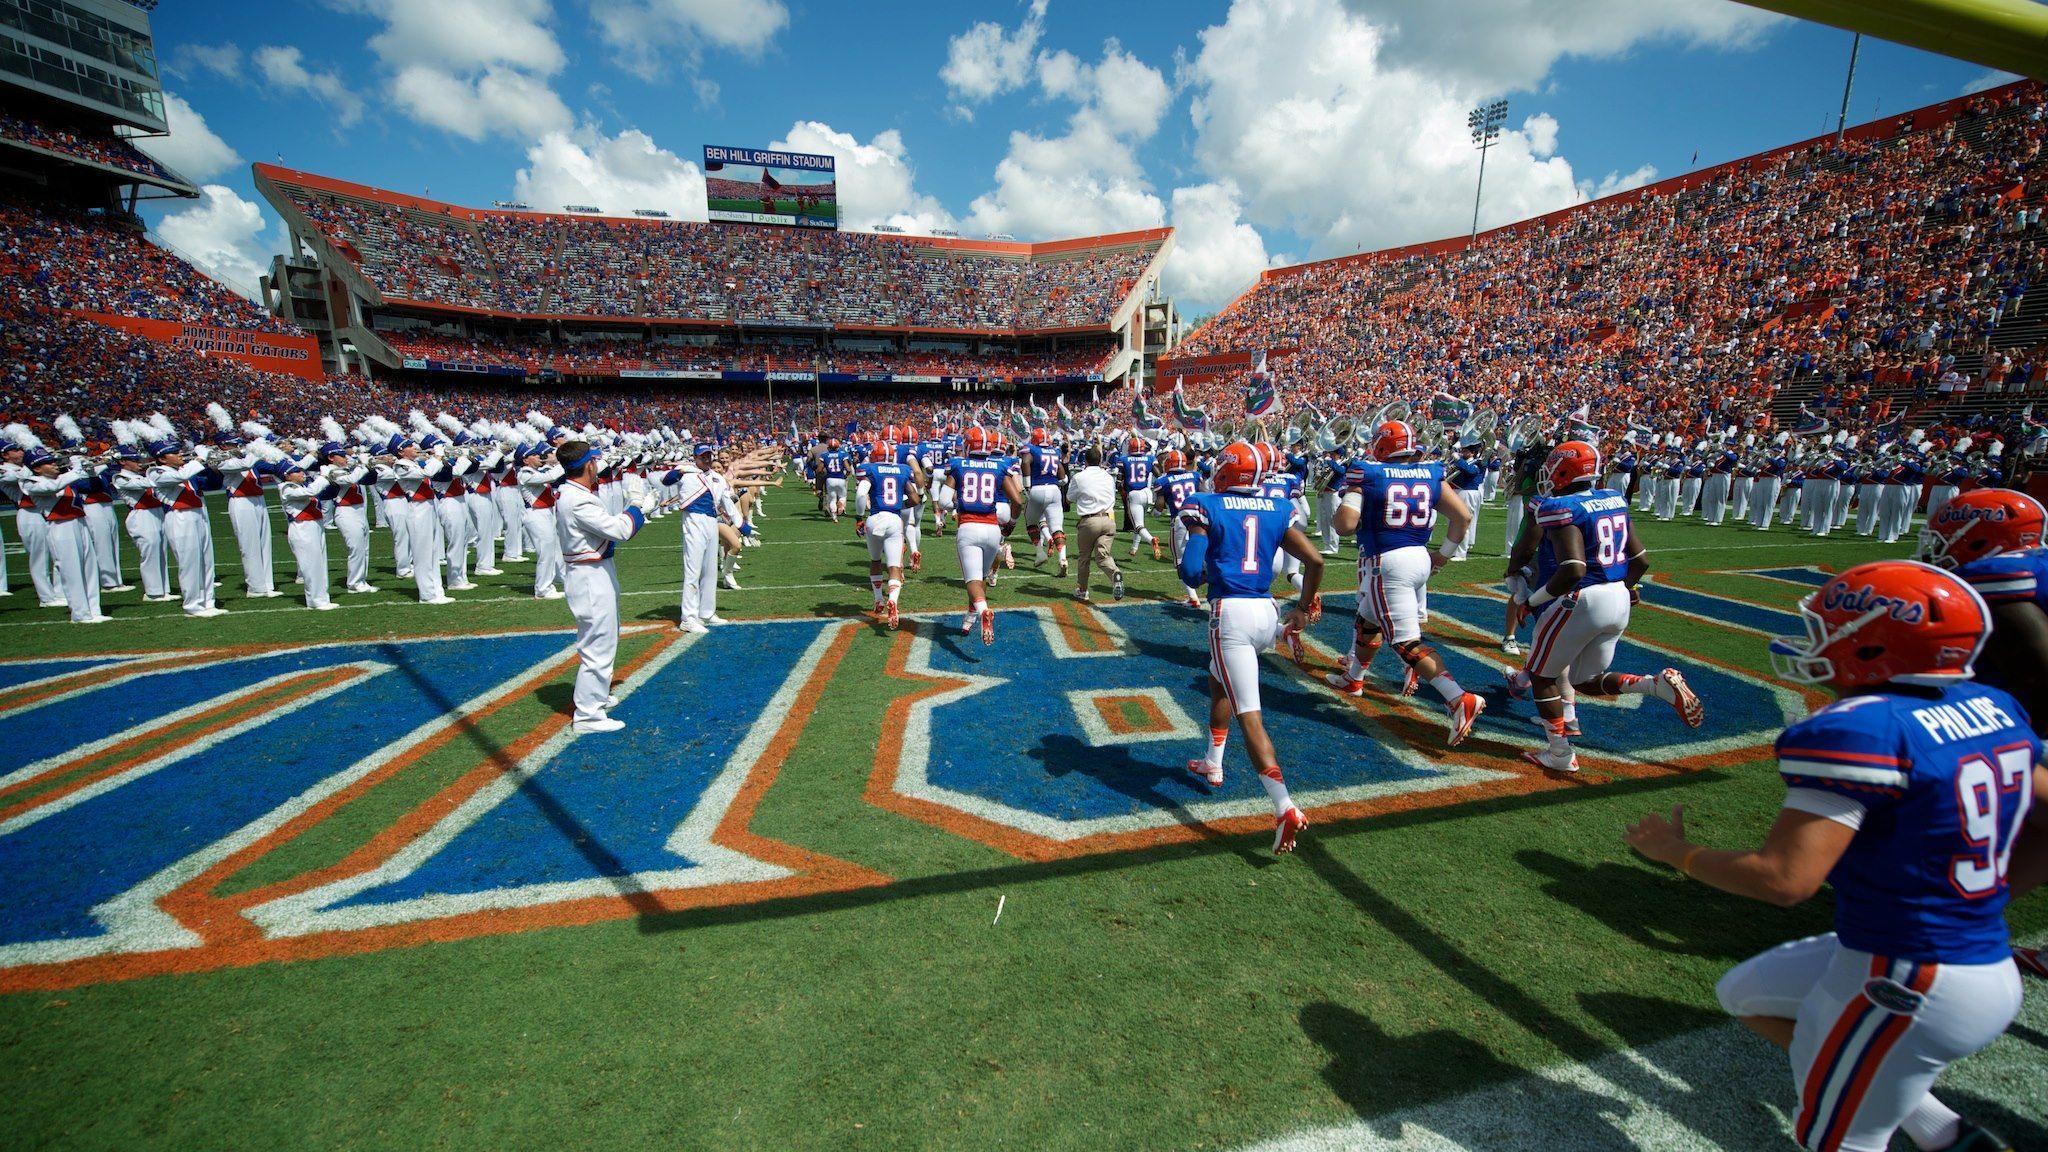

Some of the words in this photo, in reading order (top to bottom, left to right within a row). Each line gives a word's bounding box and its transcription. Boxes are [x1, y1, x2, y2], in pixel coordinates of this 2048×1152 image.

[706, 147, 728, 160] BEN
[730, 150, 752, 162] HILL
[753, 152, 791, 166] GRIFFIN
[793, 155, 833, 169] STADIUM
[759, 215, 788, 224] Publix
[182, 326, 215, 340] HOME
[217, 329, 231, 341] OF
[172, 335, 246, 355] FLORIDA
[250, 343, 309, 361] GATORS
[1163, 366, 1194, 377] GATOR
[1197, 362, 1248, 375] COUNTRY
[828, 458, 841, 473] 41
[878, 465, 901, 474] BROWN
[1041, 455, 1060, 476] 75
[1129, 463, 1147, 483] 13
[1382, 467, 1432, 479] THURMAN
[882, 476, 898, 506] 8
[962, 471, 996, 505] 88
[1222, 496, 1275, 512] DUNBAR
[1384, 483, 1432, 528] 63
[1938, 503, 2006, 525] Gators
[1241, 514, 1260, 574] 1
[1596, 512, 1629, 568] 87
[1822, 580, 1925, 626] Gators
[1911, 696, 2016, 745] PHILLIPS
[1948, 739, 2035, 899] 97
